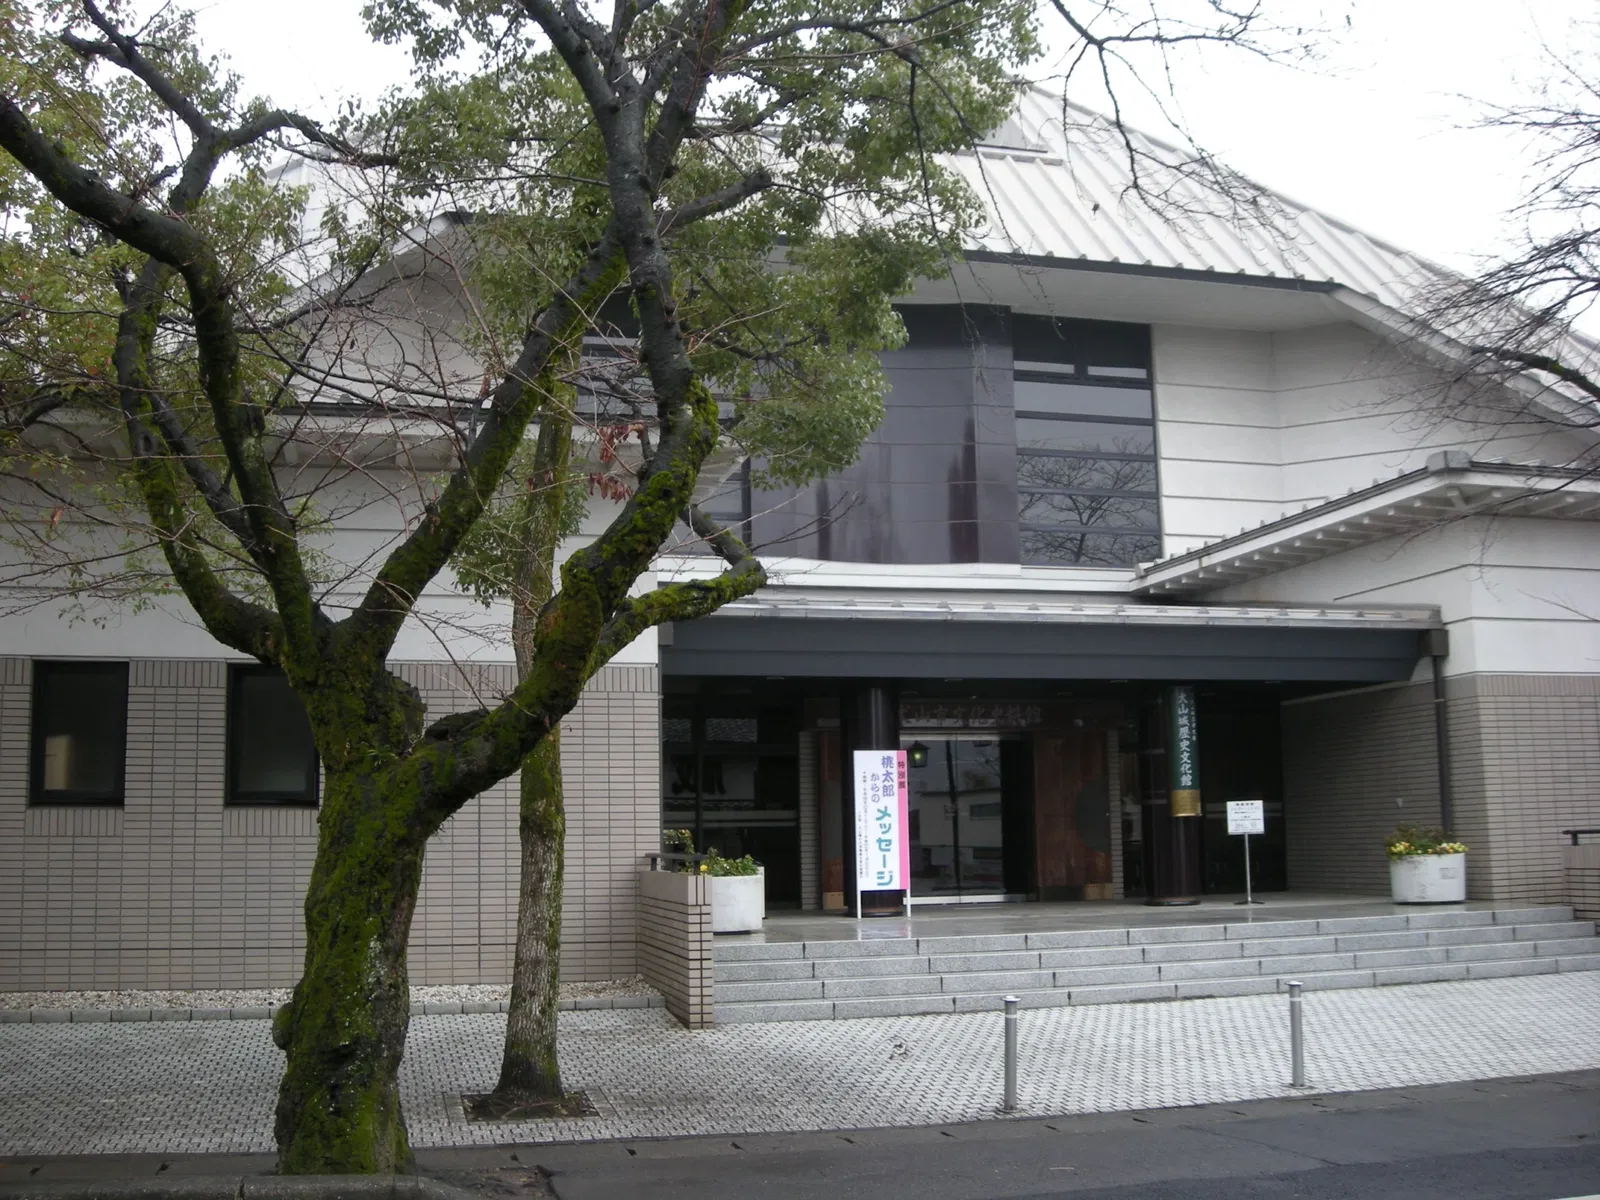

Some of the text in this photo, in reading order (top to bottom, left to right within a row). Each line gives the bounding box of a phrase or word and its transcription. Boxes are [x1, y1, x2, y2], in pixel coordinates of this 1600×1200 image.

[871, 773, 880, 803] からの
[881, 756, 895, 797] 桃太郎
[876, 806, 893, 886] メッセージ
